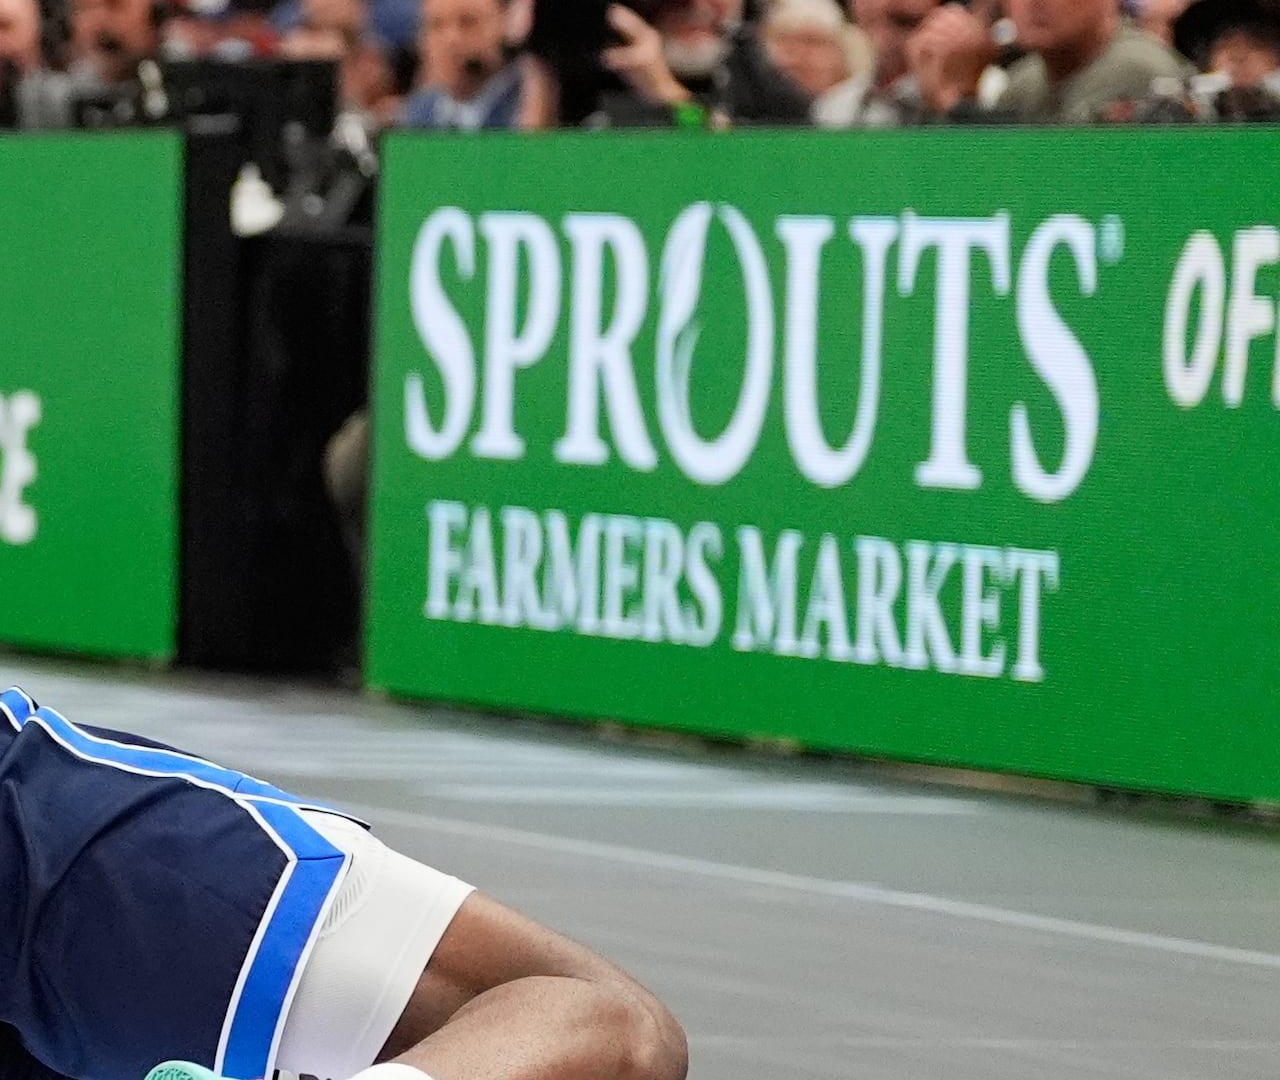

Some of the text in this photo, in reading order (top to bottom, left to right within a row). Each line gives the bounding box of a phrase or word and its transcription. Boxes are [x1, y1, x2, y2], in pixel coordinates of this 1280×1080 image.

[403, 201, 1280, 502] SPROUTS OF
[423, 498, 1059, 683] FARMERS MARKET
